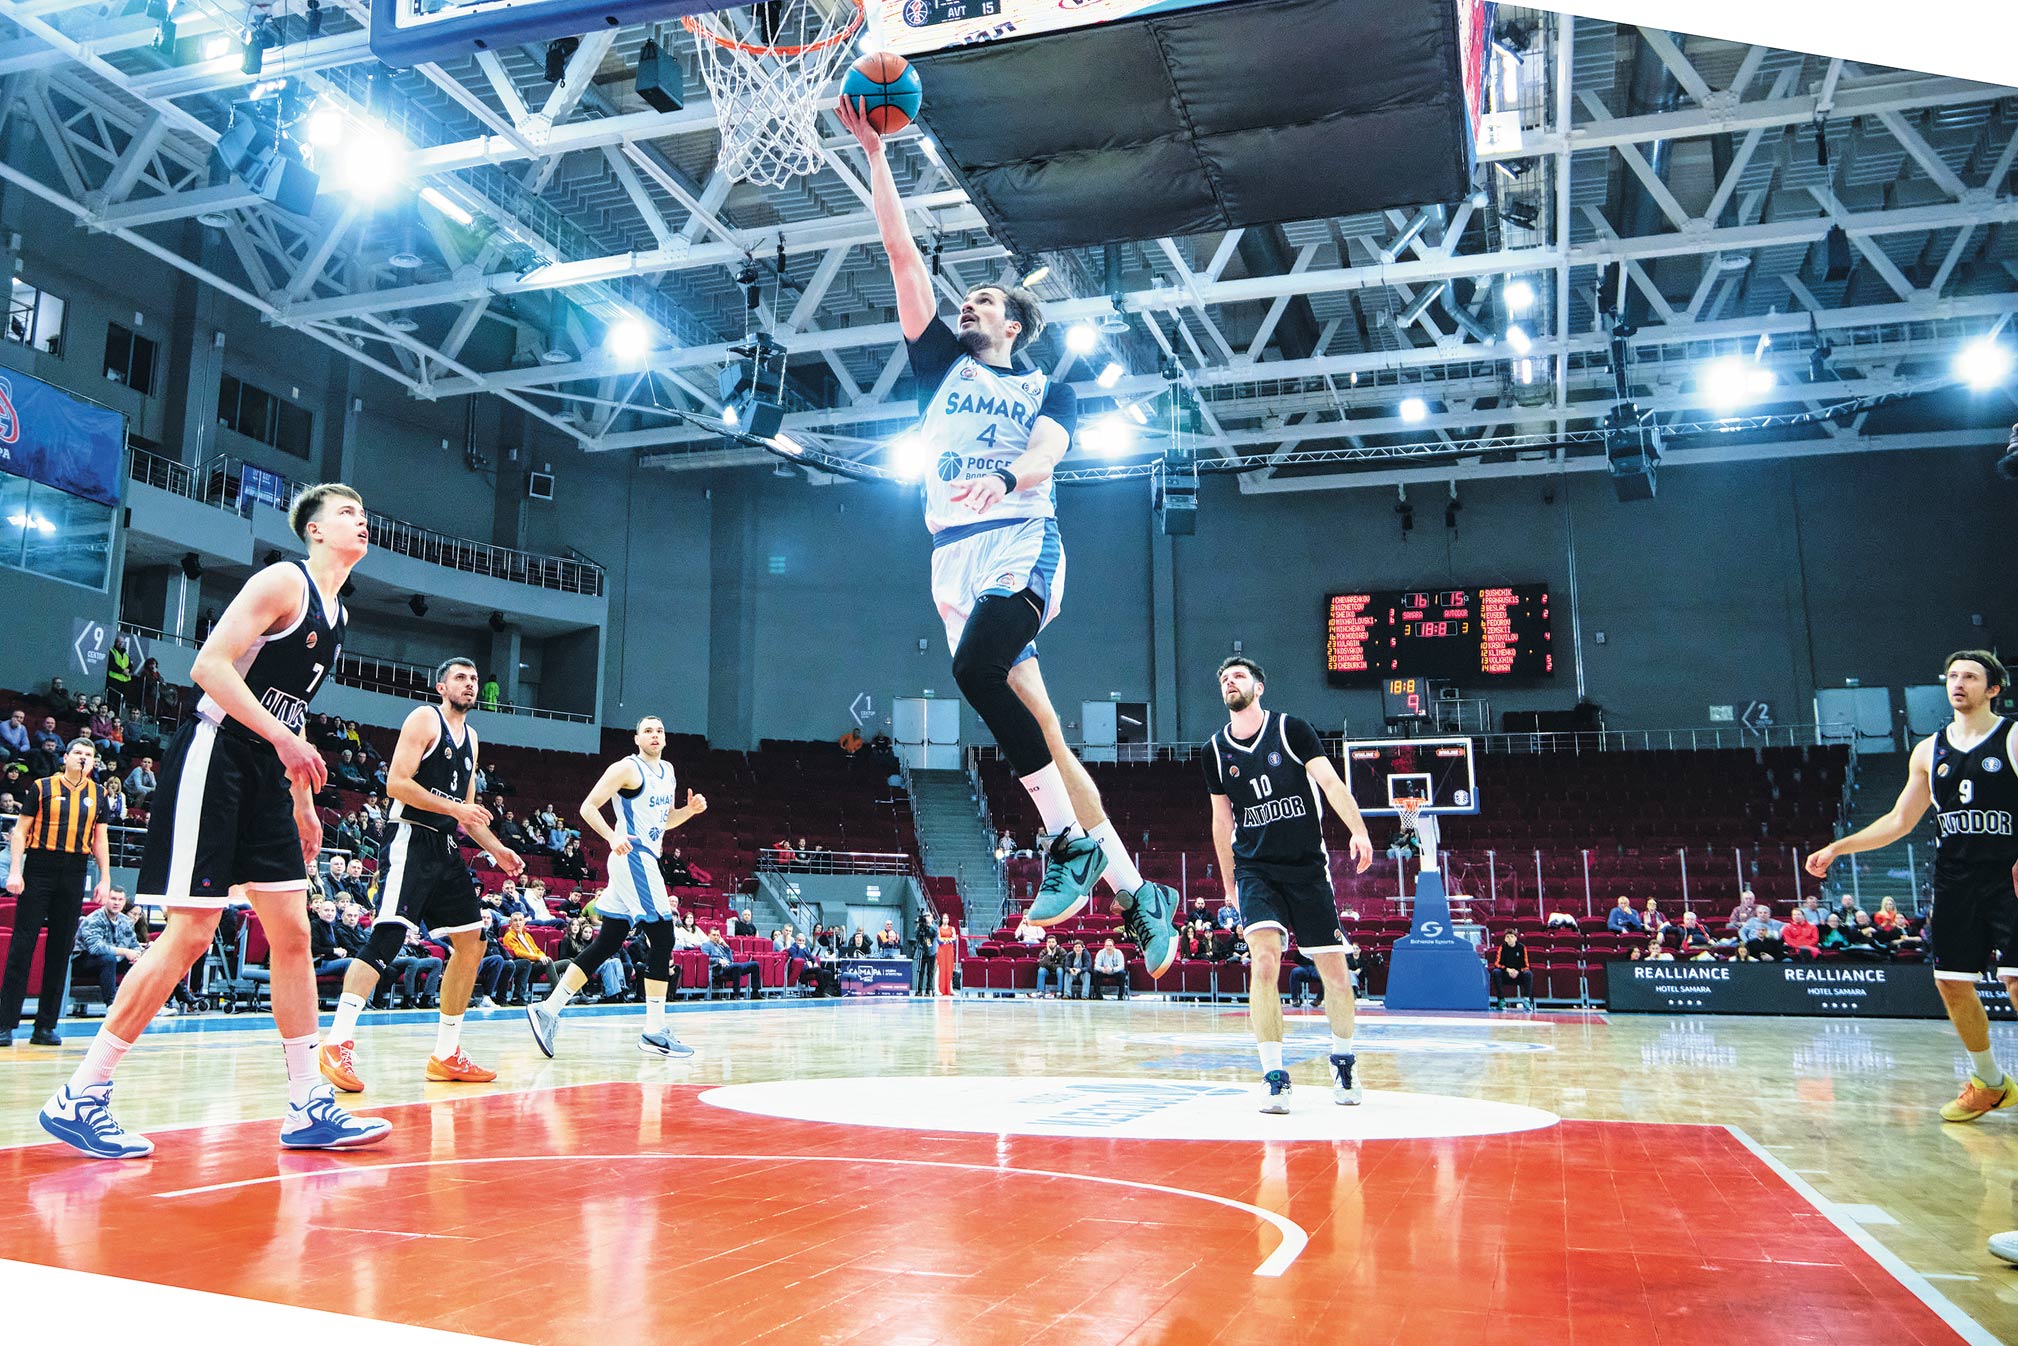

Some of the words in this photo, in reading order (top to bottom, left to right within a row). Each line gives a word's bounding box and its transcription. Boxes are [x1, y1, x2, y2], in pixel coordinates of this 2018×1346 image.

[948, 5, 966, 18] AVT
[982, 2, 994, 15] 15
[976, 423, 997, 448] 4
[1414, 593, 1427, 608] 16
[1450, 591, 1463, 606] 15
[1404, 624, 1411, 636] 3
[1462, 622, 1469, 634] 3
[94, 627, 104, 651] 9
[306, 662, 325, 693] 7
[866, 695, 871, 711] 1
[1407, 694, 1419, 714] 9
[1758, 703, 1769, 719] 2
[450, 770, 458, 791] 3
[1249, 774, 1273, 800] 10
[1959, 779, 1974, 804] 9
[1634, 967, 1730, 980] REALLIANCE
[1784, 968, 1886, 982] REALLIANCE
[1655, 985, 1679, 993] HOTEL
[1680, 985, 1712, 993] SAMARA
[1807, 987, 1833, 996] HOTEL
[1834, 988, 1867, 996] SAMARA
